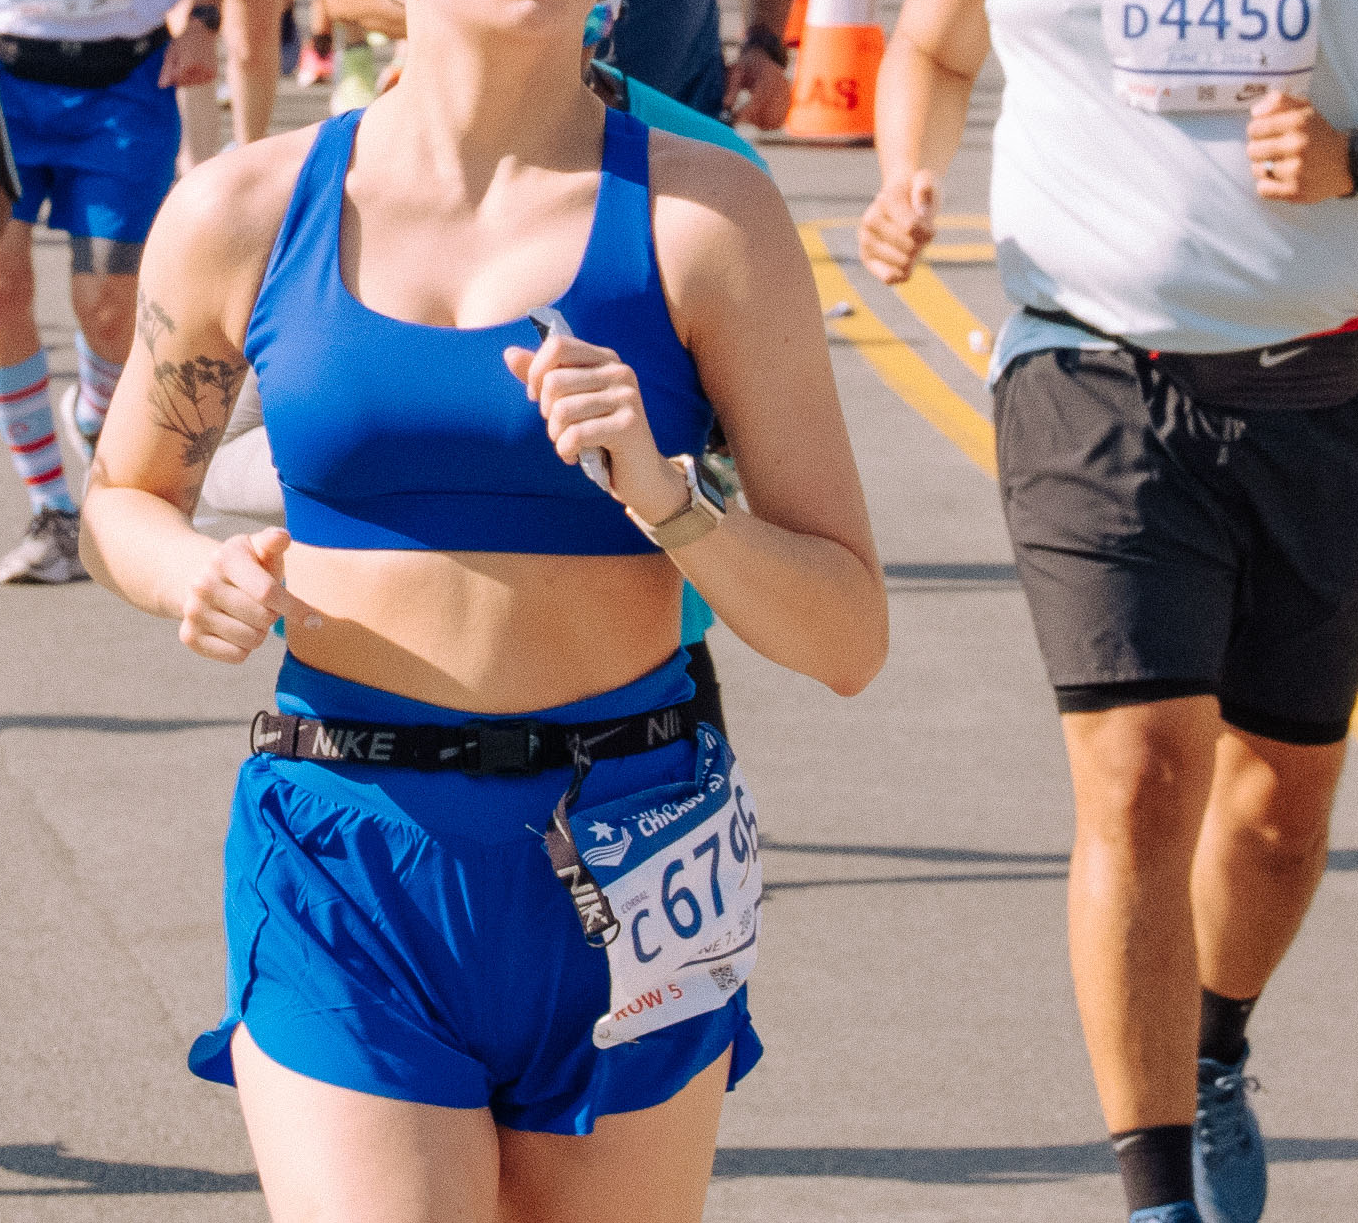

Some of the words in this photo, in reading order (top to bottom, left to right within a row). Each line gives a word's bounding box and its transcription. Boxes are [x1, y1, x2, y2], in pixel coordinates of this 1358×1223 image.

[1123, 4, 1149, 38] D
[312, 728, 397, 761] NIKE
[632, 908, 663, 965] C
[668, 983, 684, 1000] 5
